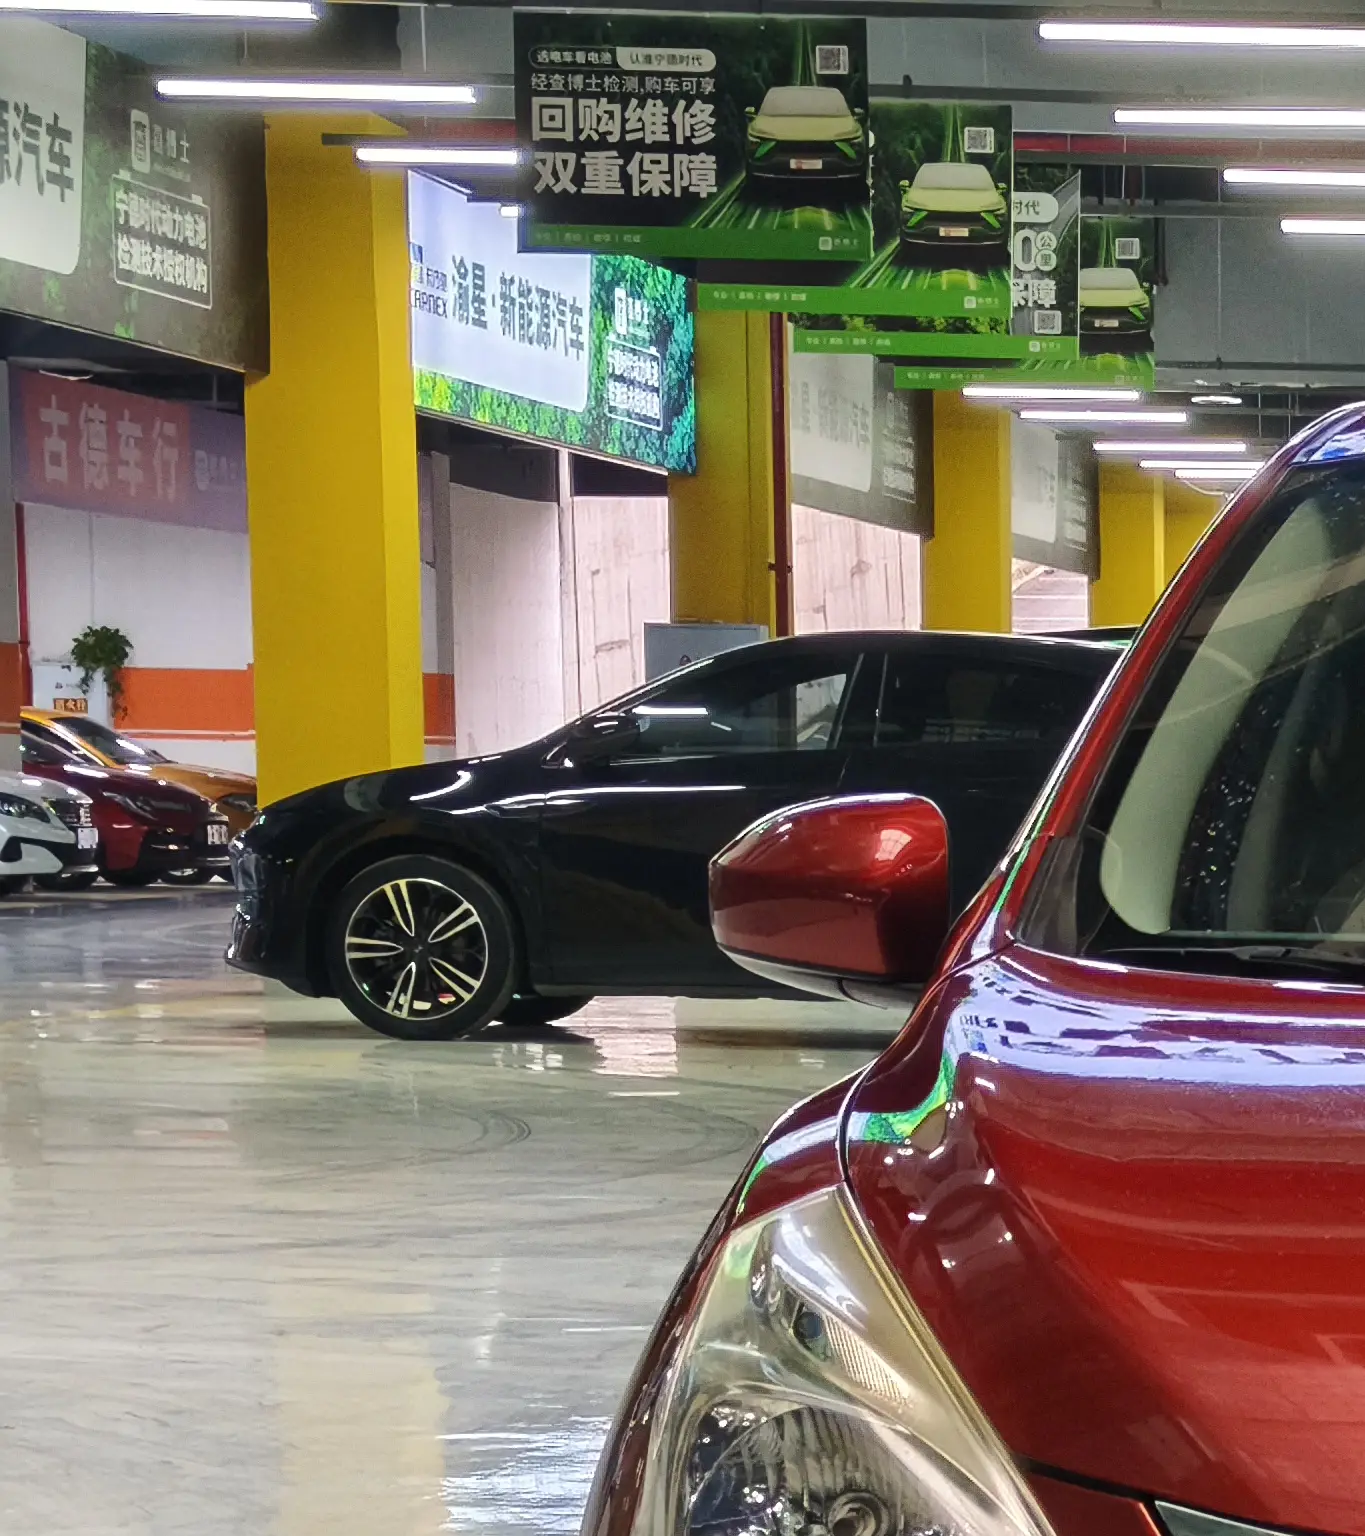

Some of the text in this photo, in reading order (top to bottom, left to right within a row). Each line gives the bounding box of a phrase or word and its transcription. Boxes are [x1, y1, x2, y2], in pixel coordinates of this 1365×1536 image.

[532, 97, 717, 145] 回购维修
[533, 151, 717, 198] 双重保障
[39, 395, 180, 499] 古德车行
